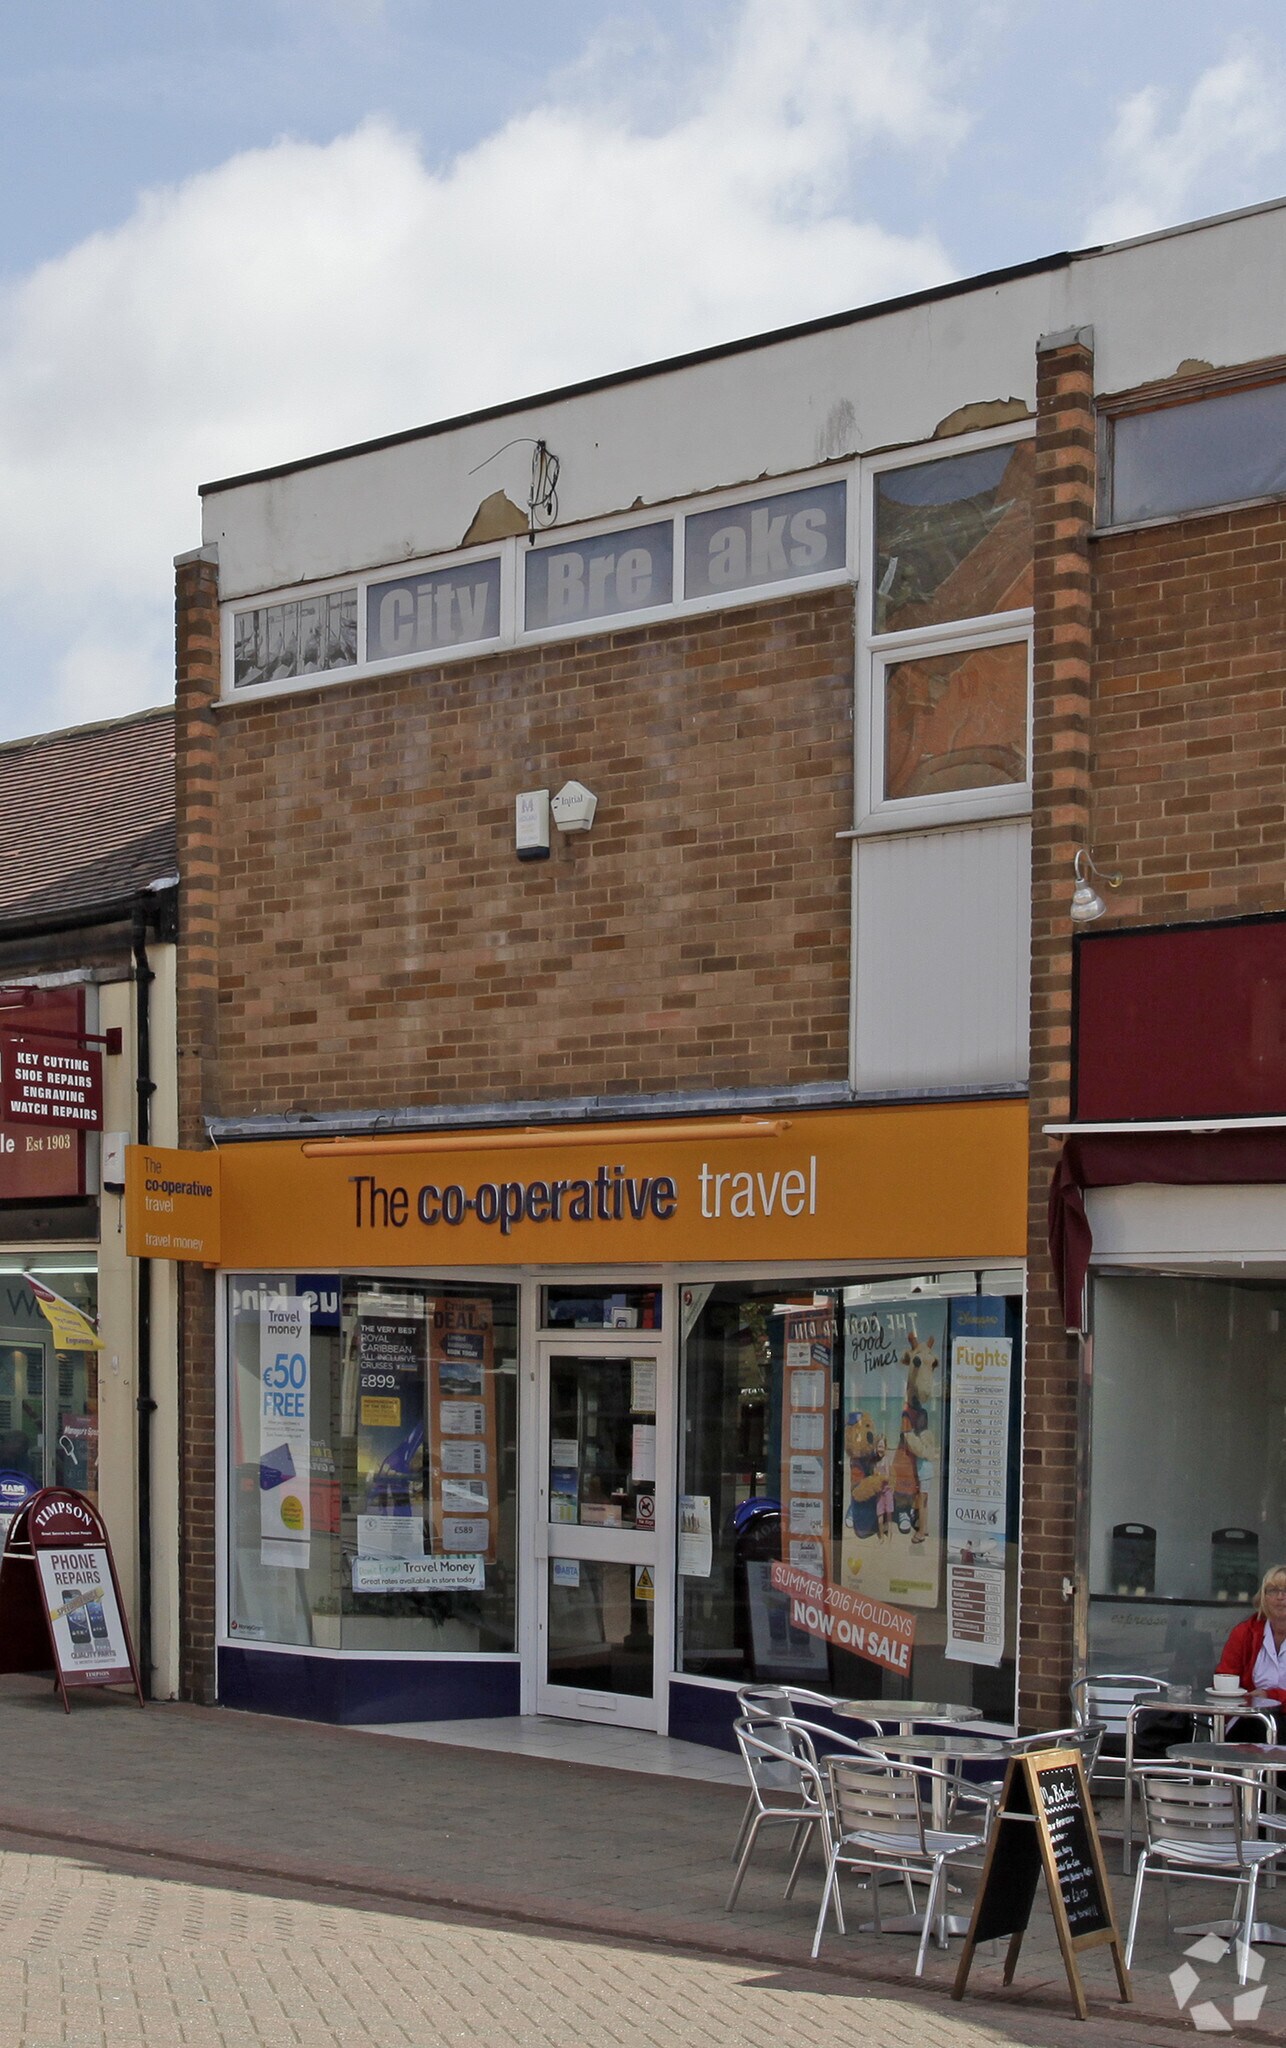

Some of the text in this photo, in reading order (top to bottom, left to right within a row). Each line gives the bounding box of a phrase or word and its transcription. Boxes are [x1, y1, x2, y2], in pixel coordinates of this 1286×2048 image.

[379, 580, 489, 654] City
[562, 795, 583, 806] Initial
[17, 1052, 89, 1071] KEY CUTTING
[15, 1068, 92, 1088] SHOE REPAIRS
[23, 1086, 85, 1103] ENGRAVING
[10, 1101, 97, 1121] WATCH REPAIRS
[25, 1136, 43, 1152] Est
[47, 1134, 71, 1150] 1903
[144, 1157, 161, 1174] The
[145, 1179, 213, 1197] co-operative
[348, 1155, 817, 1235] The co-operative travel
[145, 1196, 174, 1213] travel
[145, 1232, 204, 1252] travel money
[269, 1310, 300, 1322] Travel
[434, 1312, 488, 1330] DEALS
[267, 1325, 302, 1338] money
[361, 1334, 389, 1343] ROYAL
[361, 1344, 411, 1353] CARIBBEAN
[852, 1326, 892, 1361] good
[361, 1362, 393, 1370] CRUISES
[377, 1354, 416, 1362] INCLUSIVE
[864, 1349, 898, 1375] times
[956, 1346, 1008, 1372] Flights
[263, 1353, 306, 1389] €50
[361, 1374, 395, 1388] £899
[264, 1392, 304, 1417] FREE
[35, 1502, 92, 1527] TIMPSON
[956, 1507, 987, 1521] QATAR
[454, 1526, 473, 1534] £589
[51, 1553, 98, 1571] PHONE
[404, 1562, 437, 1572] Travel
[441, 1562, 475, 1574] Money
[55, 1571, 101, 1585] REPAIRS
[457, 1576, 476, 1584] today
[561, 1567, 578, 1576] ABTA
[775, 1566, 912, 1636] SUMMER 2016 HOLIDAYS
[794, 1600, 909, 1669] NOW ON SALE
